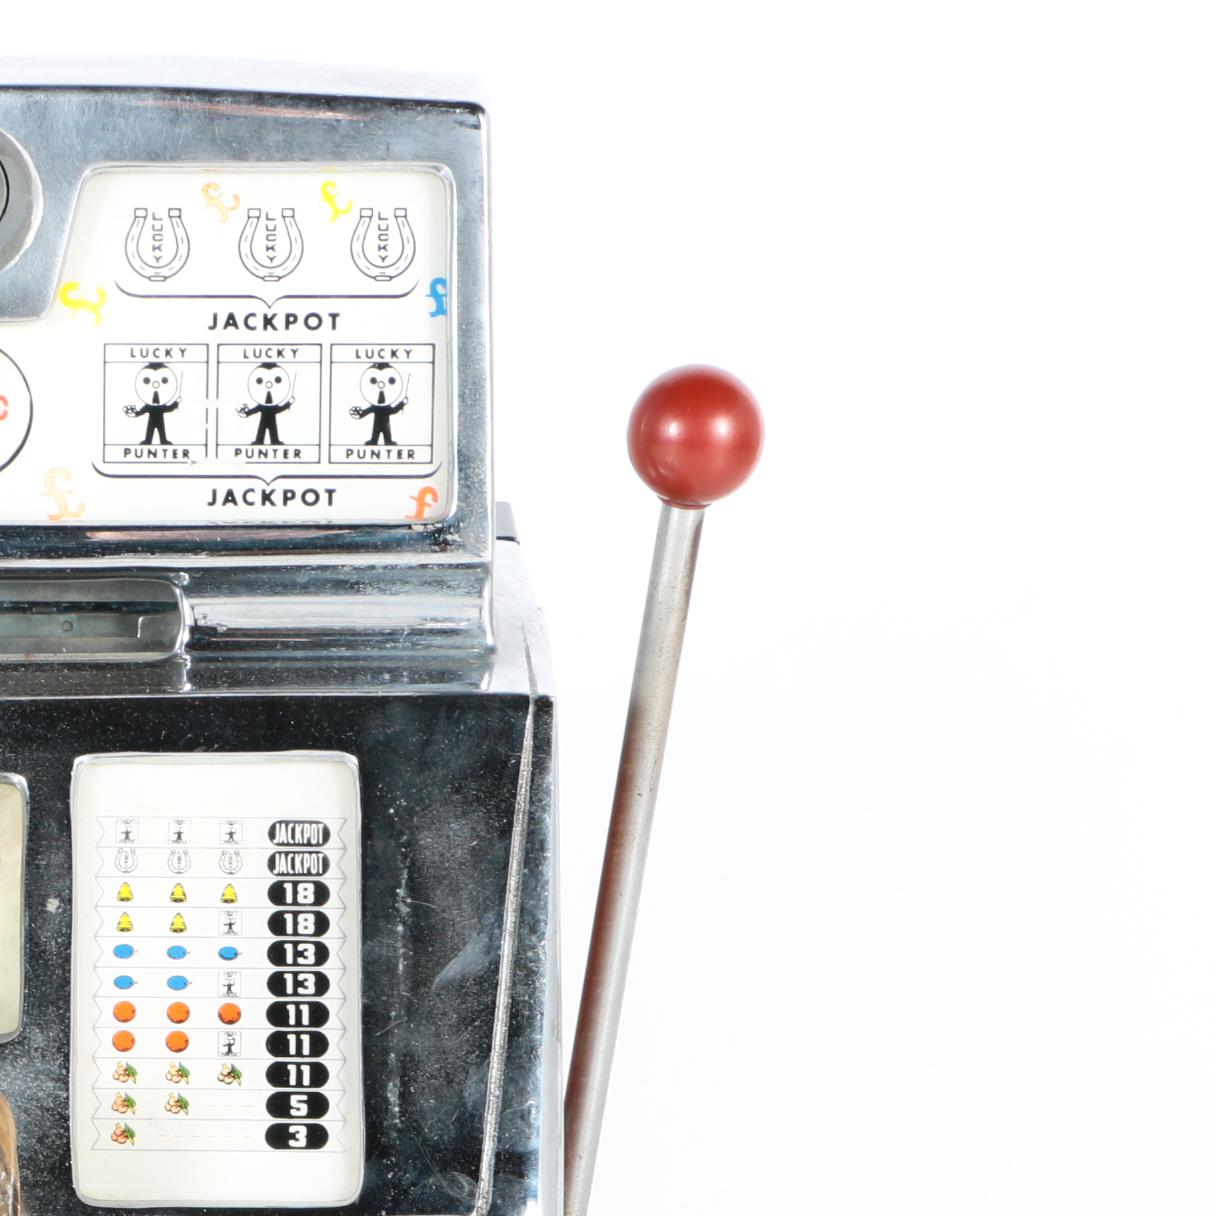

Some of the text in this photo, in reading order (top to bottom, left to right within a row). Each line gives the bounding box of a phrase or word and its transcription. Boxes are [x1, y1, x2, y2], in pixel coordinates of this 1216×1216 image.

[152, 211, 164, 263] LUCKY
[266, 211, 278, 263] LUCKY
[378, 211, 390, 263] LUCKY
[208, 312, 341, 331] JACKPOT
[130, 347, 188, 359] LUCKY
[243, 347, 299, 359] LUCKY
[356, 347, 413, 360] LUCKY
[123, 447, 191, 460] PUNTER
[234, 447, 303, 460] PUNTER
[346, 447, 416, 460] PUNTER
[207, 488, 337, 507] JACKPOT
[272, 823, 325, 845] JACKPOT
[272, 853, 325, 876] JACKPOT
[284, 882, 315, 903] 18
[284, 912, 315, 934] 18
[284, 943, 315, 964] 13
[284, 973, 315, 995] 13
[286, 1003, 310, 1025] 11
[286, 1033, 310, 1055] 11
[286, 1064, 310, 1086] 11
[289, 1094, 308, 1117] 5
[288, 1125, 307, 1148] 3
